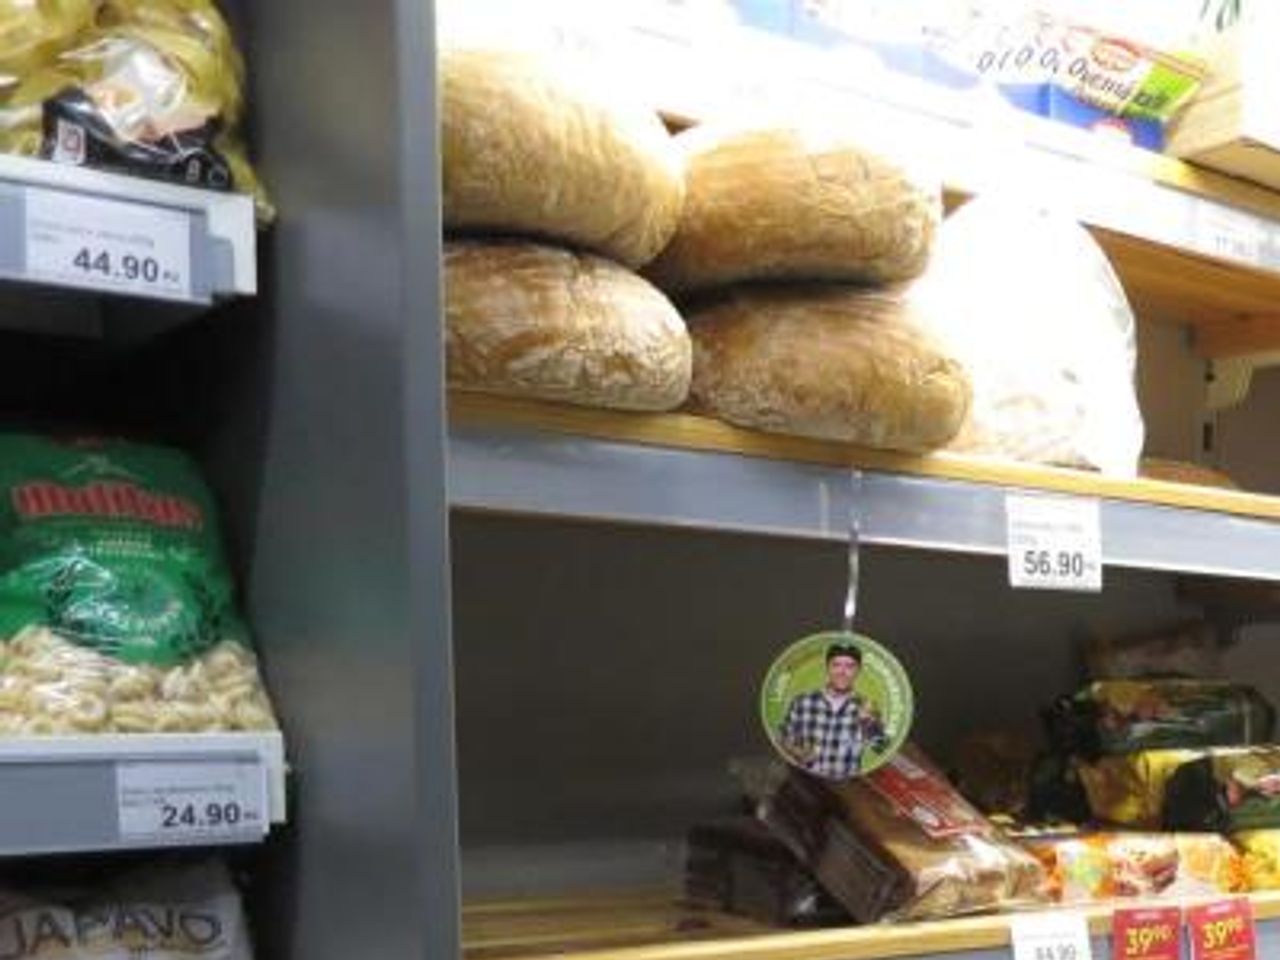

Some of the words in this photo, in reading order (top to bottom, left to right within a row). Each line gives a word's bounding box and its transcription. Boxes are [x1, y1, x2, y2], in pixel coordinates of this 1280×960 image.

[73, 247, 159, 283] 44.90
[1023, 550, 1084, 578] 56.90
[162, 802, 241, 828] 24.90
